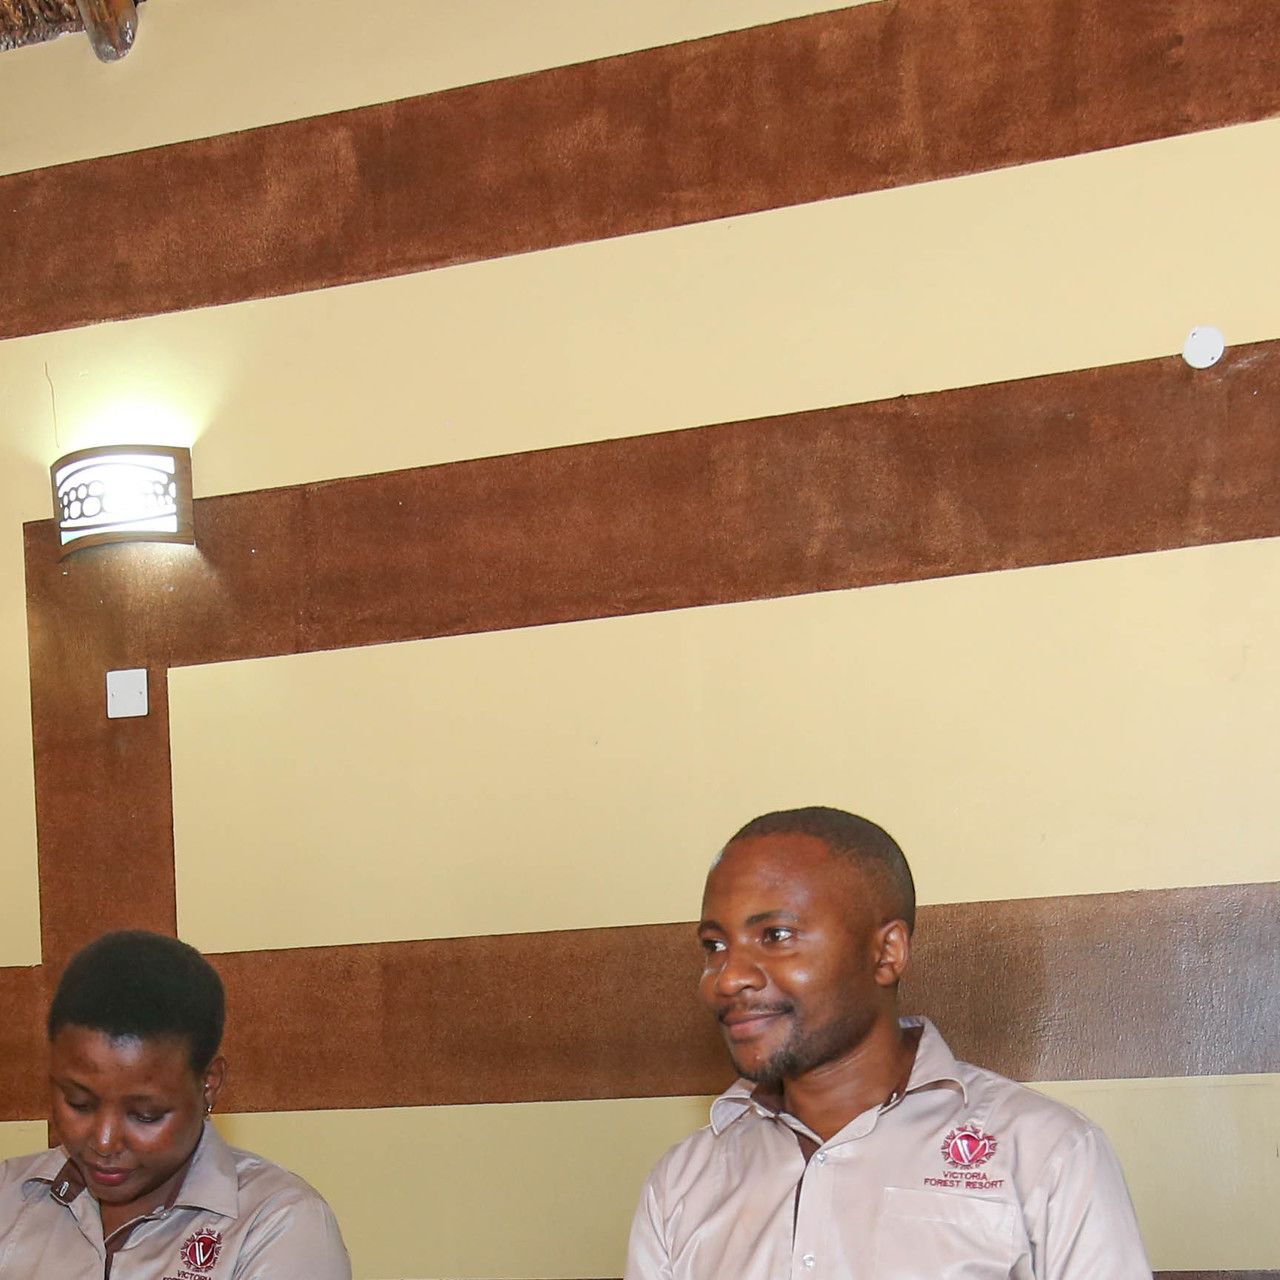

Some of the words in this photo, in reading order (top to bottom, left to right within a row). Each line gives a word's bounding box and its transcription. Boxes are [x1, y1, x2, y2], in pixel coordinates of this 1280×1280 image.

[943, 1170, 988, 1180] VICTORIA
[923, 1178, 961, 1188] FOREST
[965, 1180, 1004, 1189] RESORT
